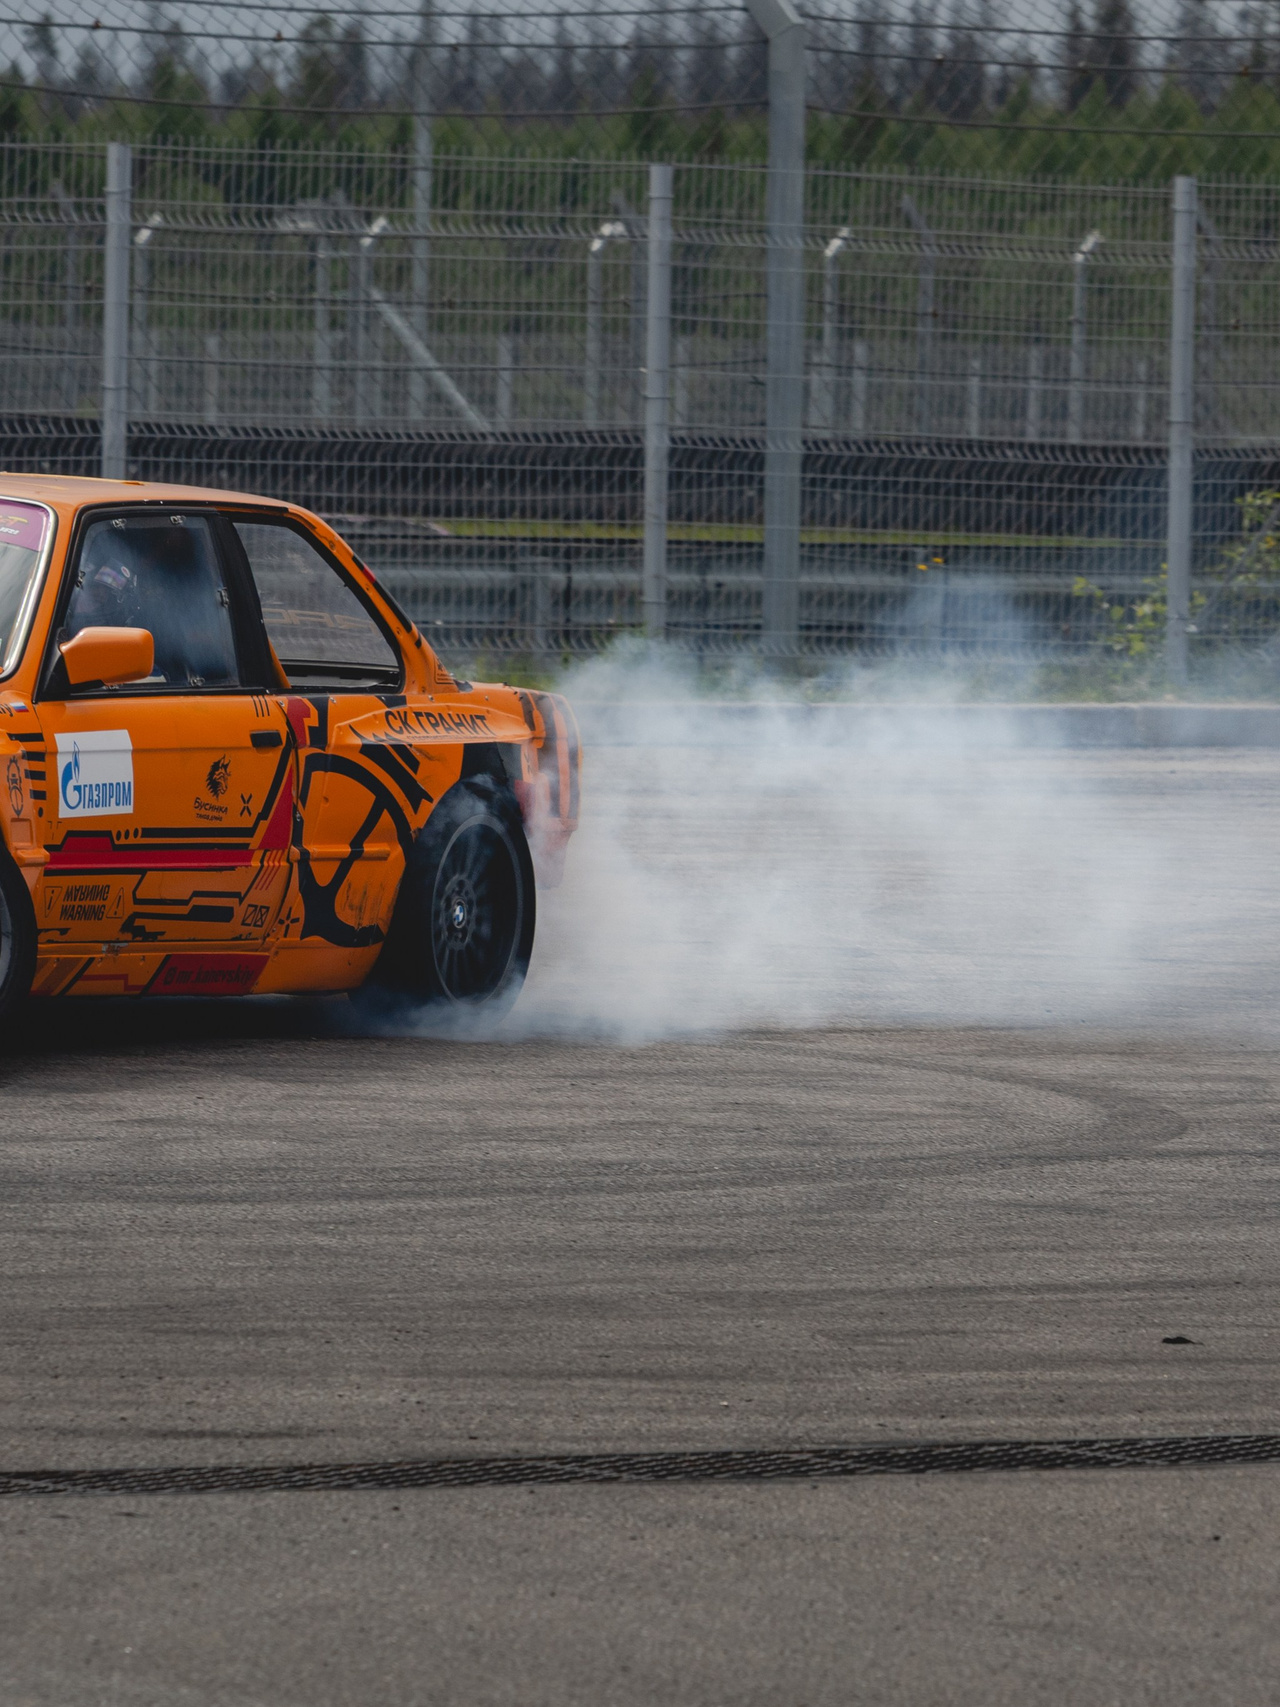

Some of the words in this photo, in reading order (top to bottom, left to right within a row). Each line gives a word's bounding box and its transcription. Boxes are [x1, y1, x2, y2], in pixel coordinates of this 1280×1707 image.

[384, 710, 420, 735] СК
[412, 711, 498, 737] ГРАНИТ
[82, 781, 132, 809] ГАЗПРОМ
[60, 904, 106, 921] WARNING
